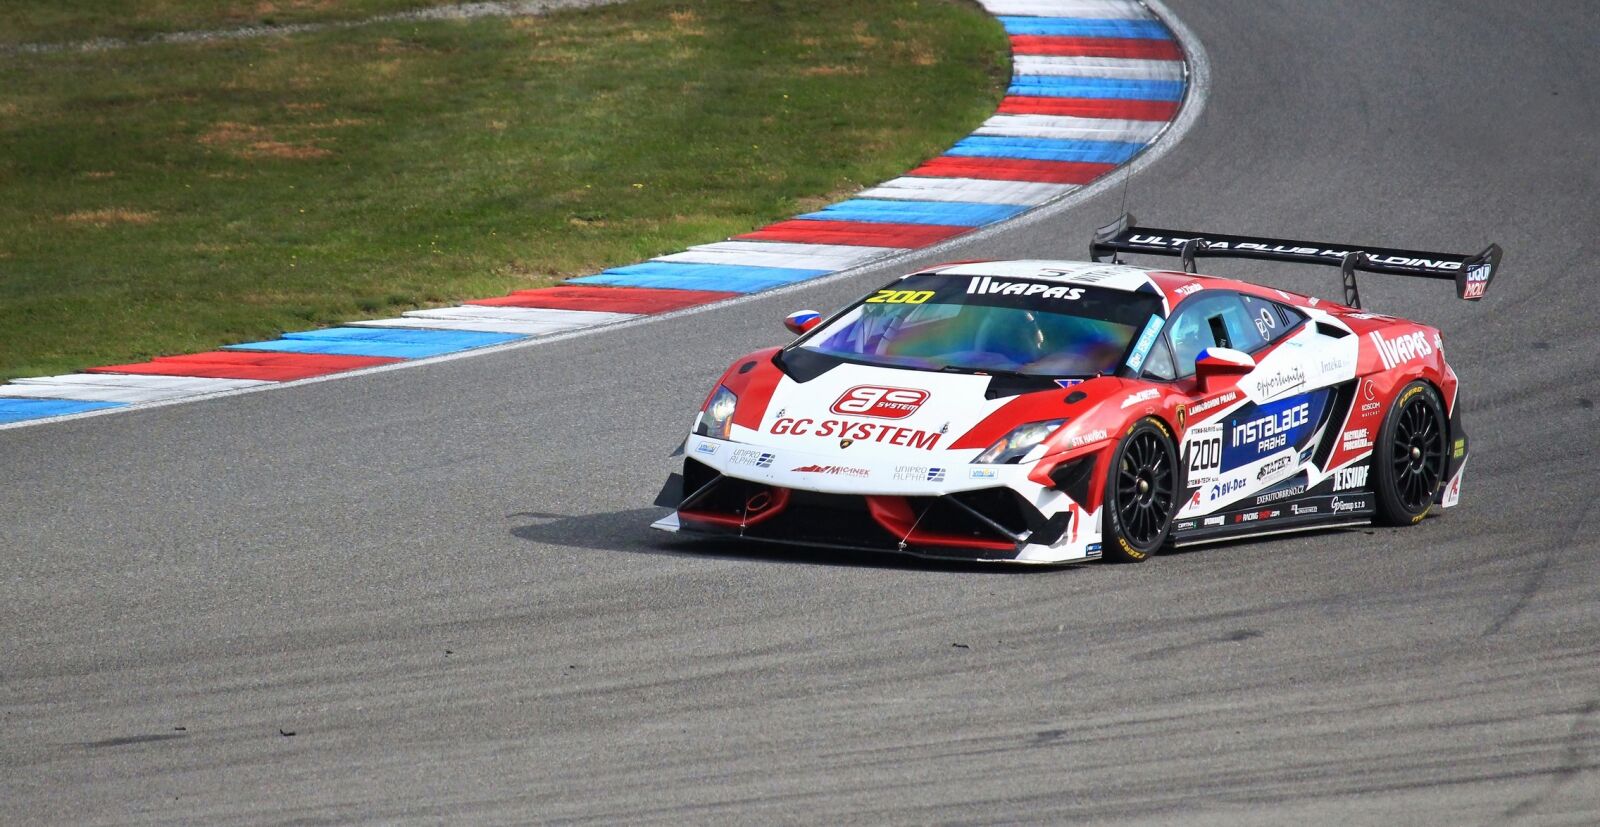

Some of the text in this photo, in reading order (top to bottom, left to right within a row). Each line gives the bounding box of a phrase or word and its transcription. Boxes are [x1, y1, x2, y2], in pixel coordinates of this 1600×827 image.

[1128, 234, 1463, 270] ULTA PLUS HLDING
[864, 290, 936, 304] 200
[1256, 366, 1306, 398] opportunity
[876, 401, 918, 411] SYSTEM
[769, 417, 943, 451] GC SYSTEM
[1190, 437, 1221, 472] 200
[1332, 464, 1370, 492] JETSURF
